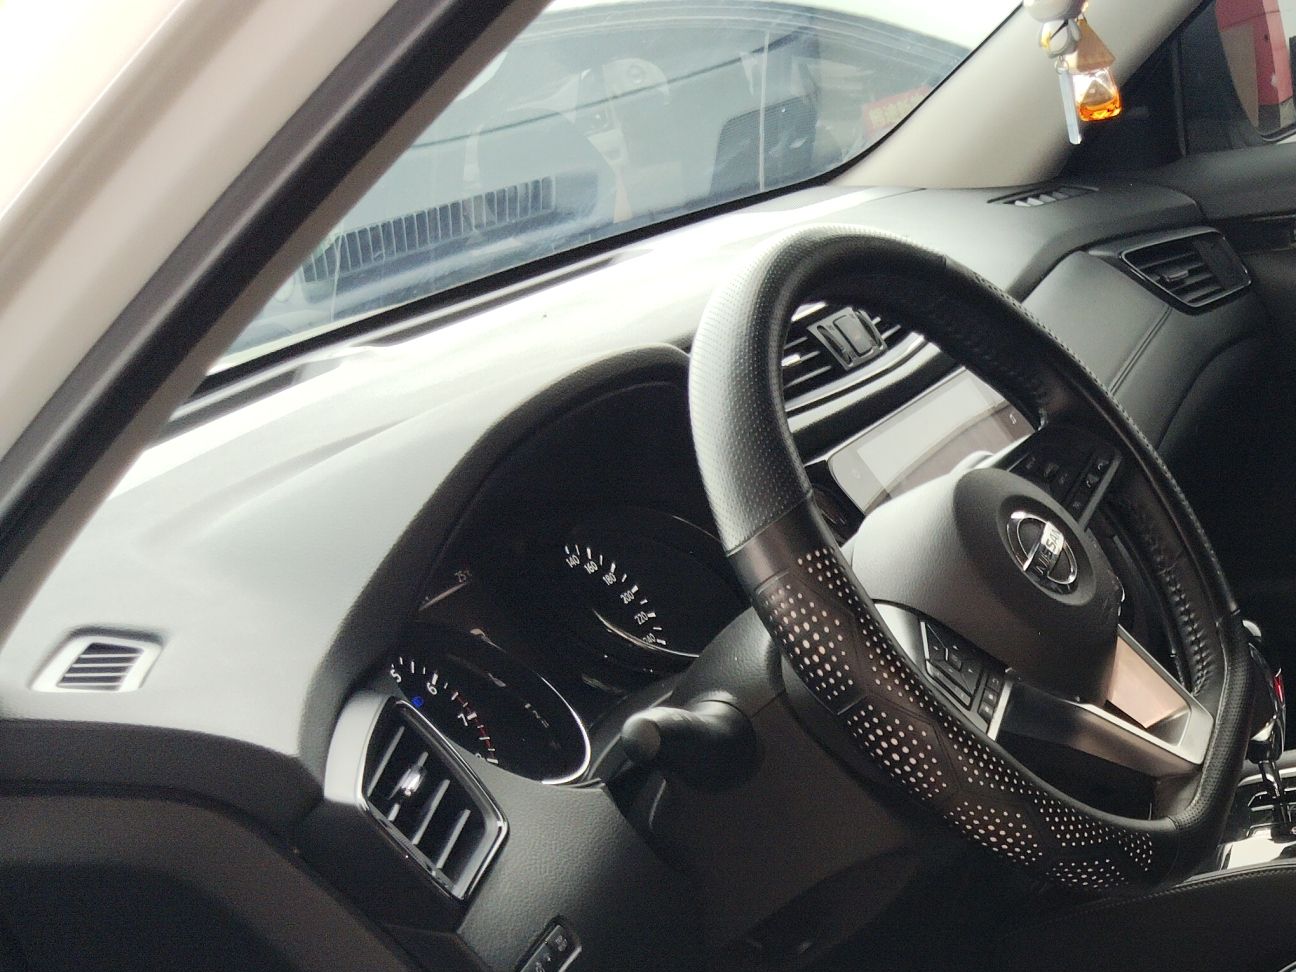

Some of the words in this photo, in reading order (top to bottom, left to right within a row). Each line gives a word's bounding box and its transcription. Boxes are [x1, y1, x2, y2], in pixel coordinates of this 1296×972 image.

[1033, 528, 1061, 575] NISSAN
[566, 554, 580, 568] 140
[584, 561, 598, 575] 160
[603, 572, 616, 586] 180
[620, 590, 634, 604] 200
[635, 611, 648, 625] 220
[390, 669, 402, 683] 5
[426, 681, 438, 695] 6
[457, 713, 468, 727] 7
